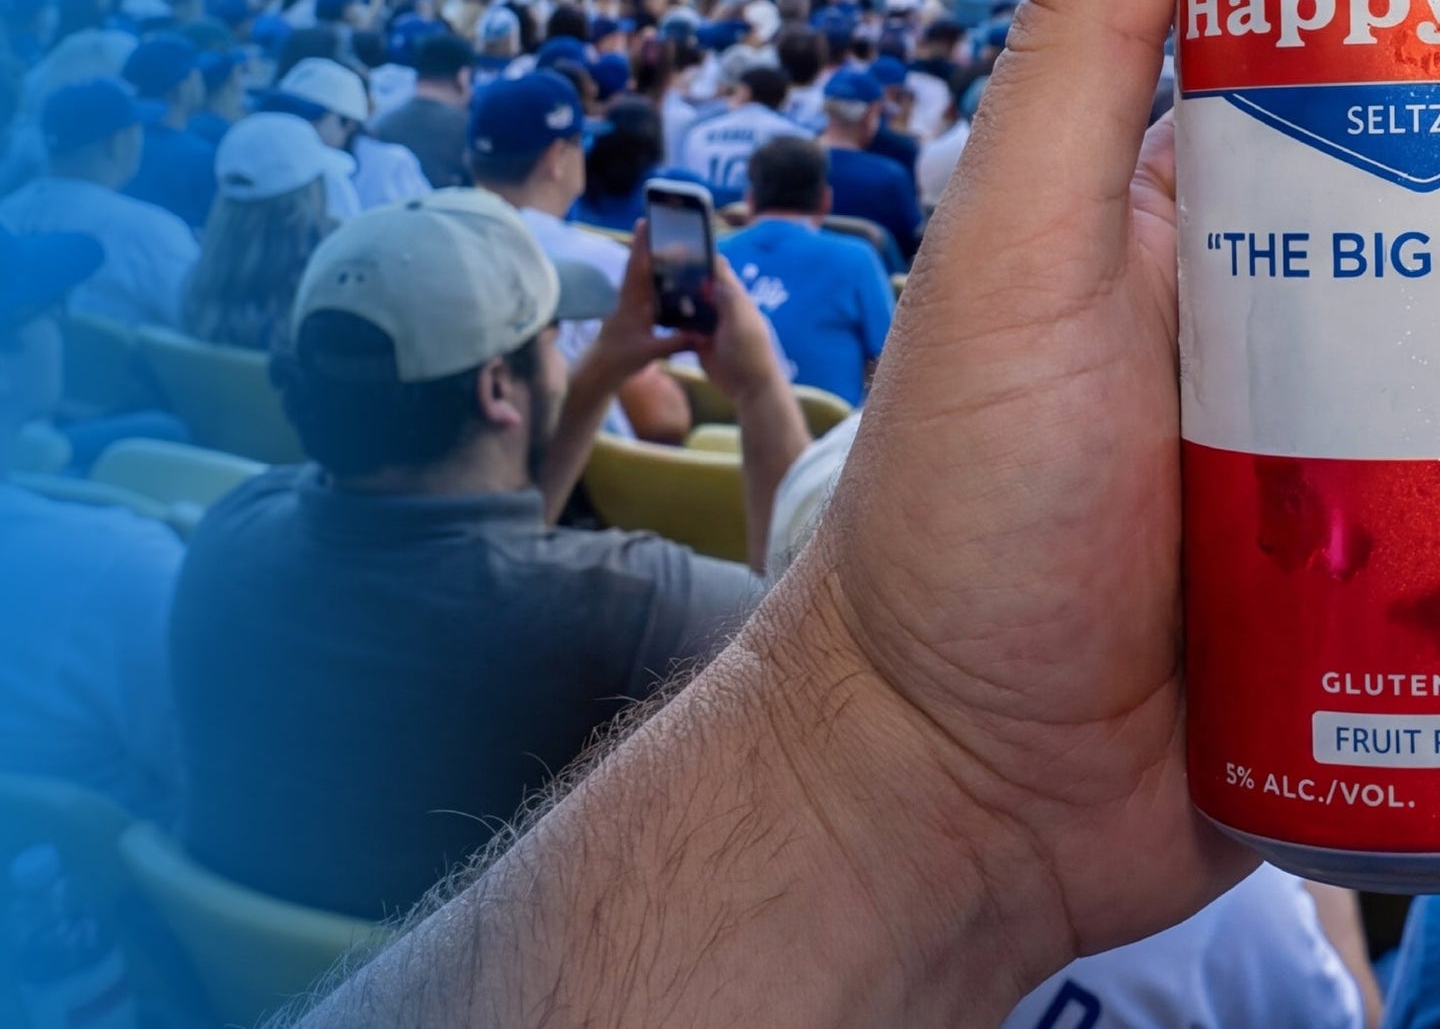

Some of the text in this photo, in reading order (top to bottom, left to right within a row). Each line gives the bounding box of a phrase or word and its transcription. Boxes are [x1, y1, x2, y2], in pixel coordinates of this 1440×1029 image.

[1207, 229, 1311, 279] “THE
[1332, 230, 1432, 279] BIG
[1335, 725, 1422, 755] FRUIT
[1224, 761, 1255, 789] 5%
[1262, 772, 1416, 809] ALC./VOL.
